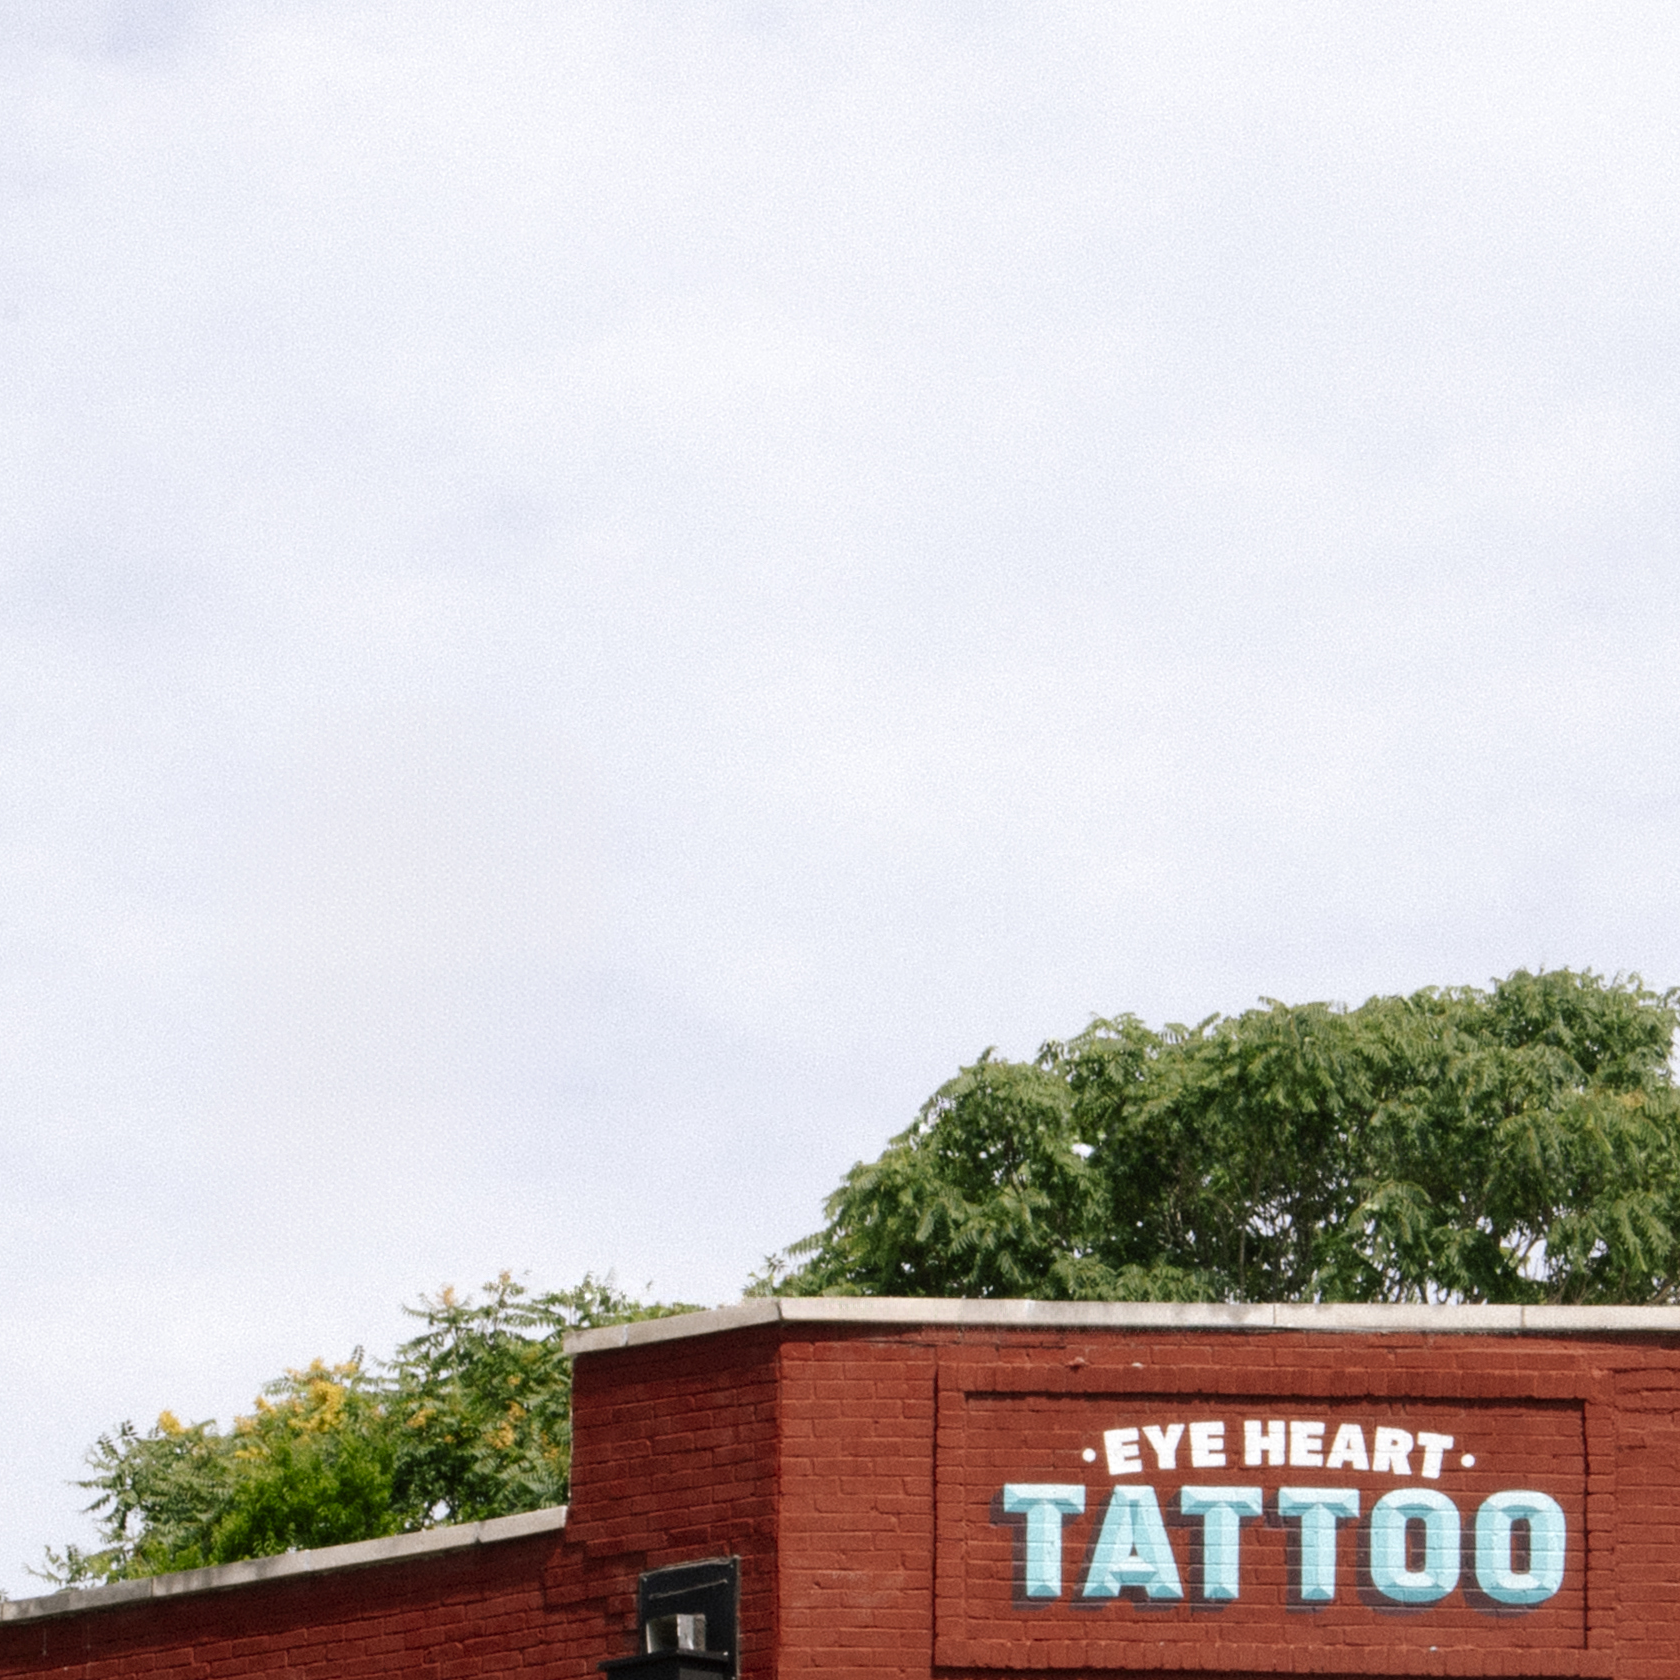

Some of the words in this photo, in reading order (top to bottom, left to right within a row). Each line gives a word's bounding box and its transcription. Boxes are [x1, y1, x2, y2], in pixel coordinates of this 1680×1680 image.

[1102, 1420, 1226, 1476] EYE
[1243, 1420, 1455, 1479] HEART
[1003, 1483, 1567, 1605] TATTOO
